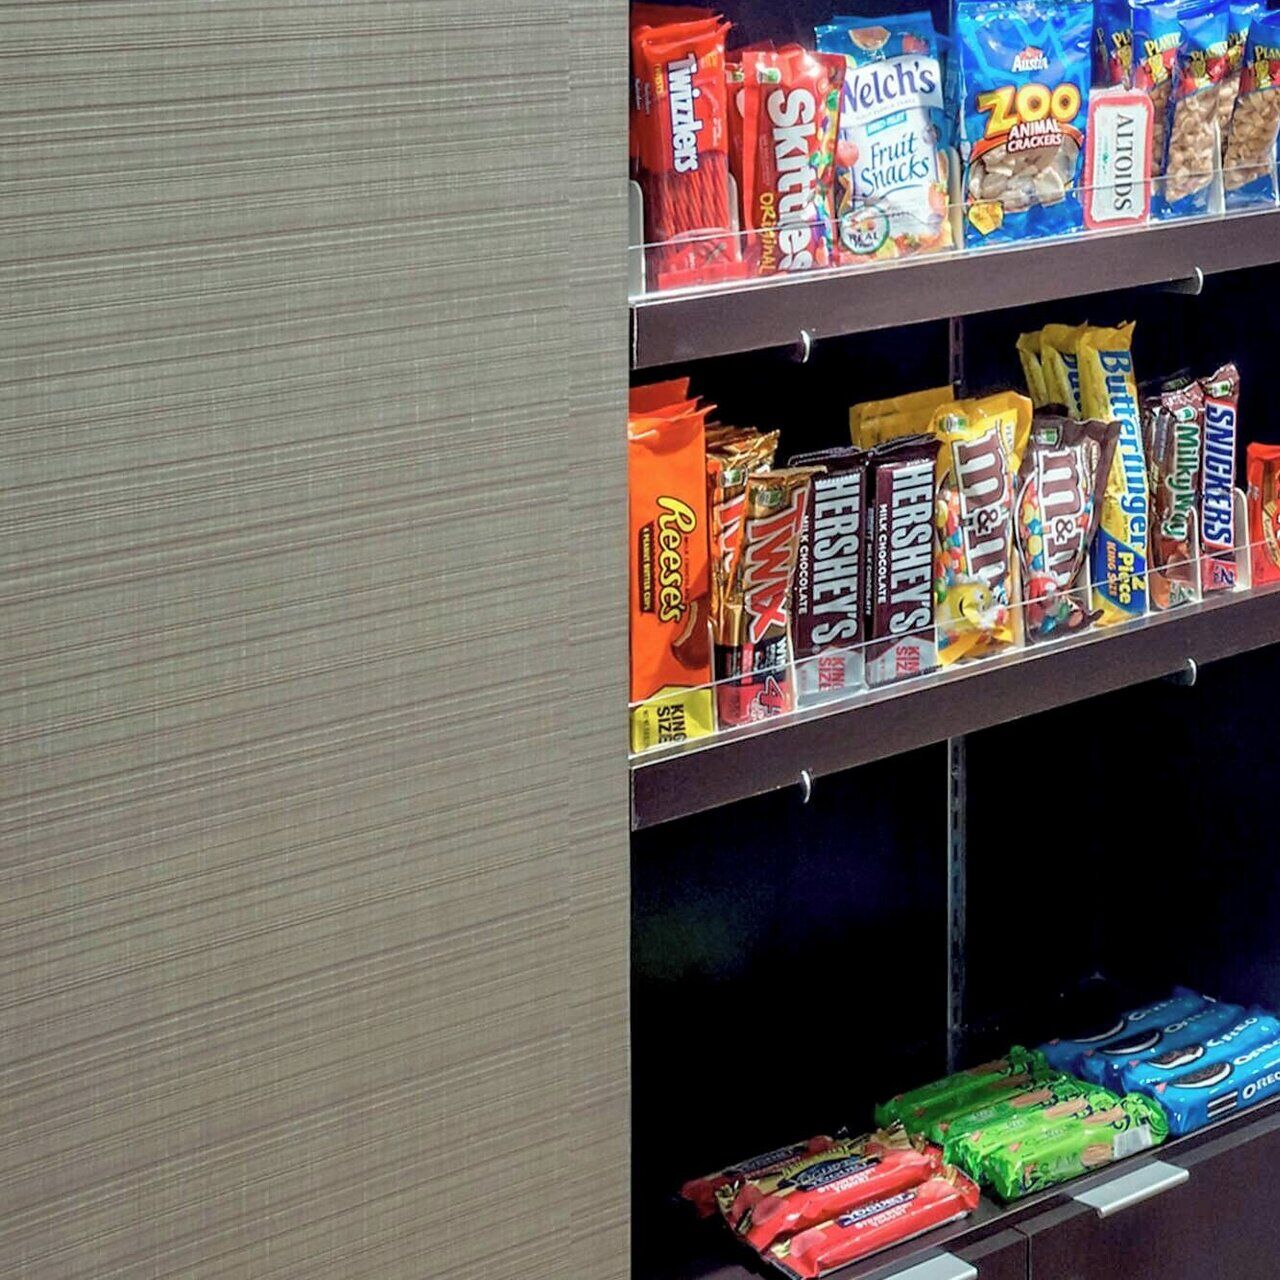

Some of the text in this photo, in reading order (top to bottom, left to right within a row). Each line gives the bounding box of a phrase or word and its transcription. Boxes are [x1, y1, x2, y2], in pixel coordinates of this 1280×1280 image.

[668, 52, 703, 173] Twizzlers
[977, 83, 1081, 140] ZOO
[1007, 133, 1062, 153] CRACKERS
[1008, 118, 1062, 140] ANIMAL
[768, 88, 817, 269] Skittles
[861, 156, 930, 198] Snacks
[870, 132, 919, 169] Fruit
[1114, 113, 1134, 211] ALTOIDS
[1099, 350, 1148, 554] Butterfinger
[1167, 424, 1199, 490] Milky
[1205, 403, 1235, 545] SNICKERS
[657, 496, 697, 623] Reese's
[746, 484, 809, 643] TWIX
[798, 545, 809, 616] CHOCOLATE
[811, 474, 861, 645] HERSHEY'S
[877, 503, 888, 605] MILK CHOCOLATE
[889, 462, 935, 636] HERSHEY'S
[1118, 551, 1135, 604] Piece
[1132, 577, 1146, 591] 2
[657, 706, 672, 744] SIZE
[671, 704, 687, 742] KING
